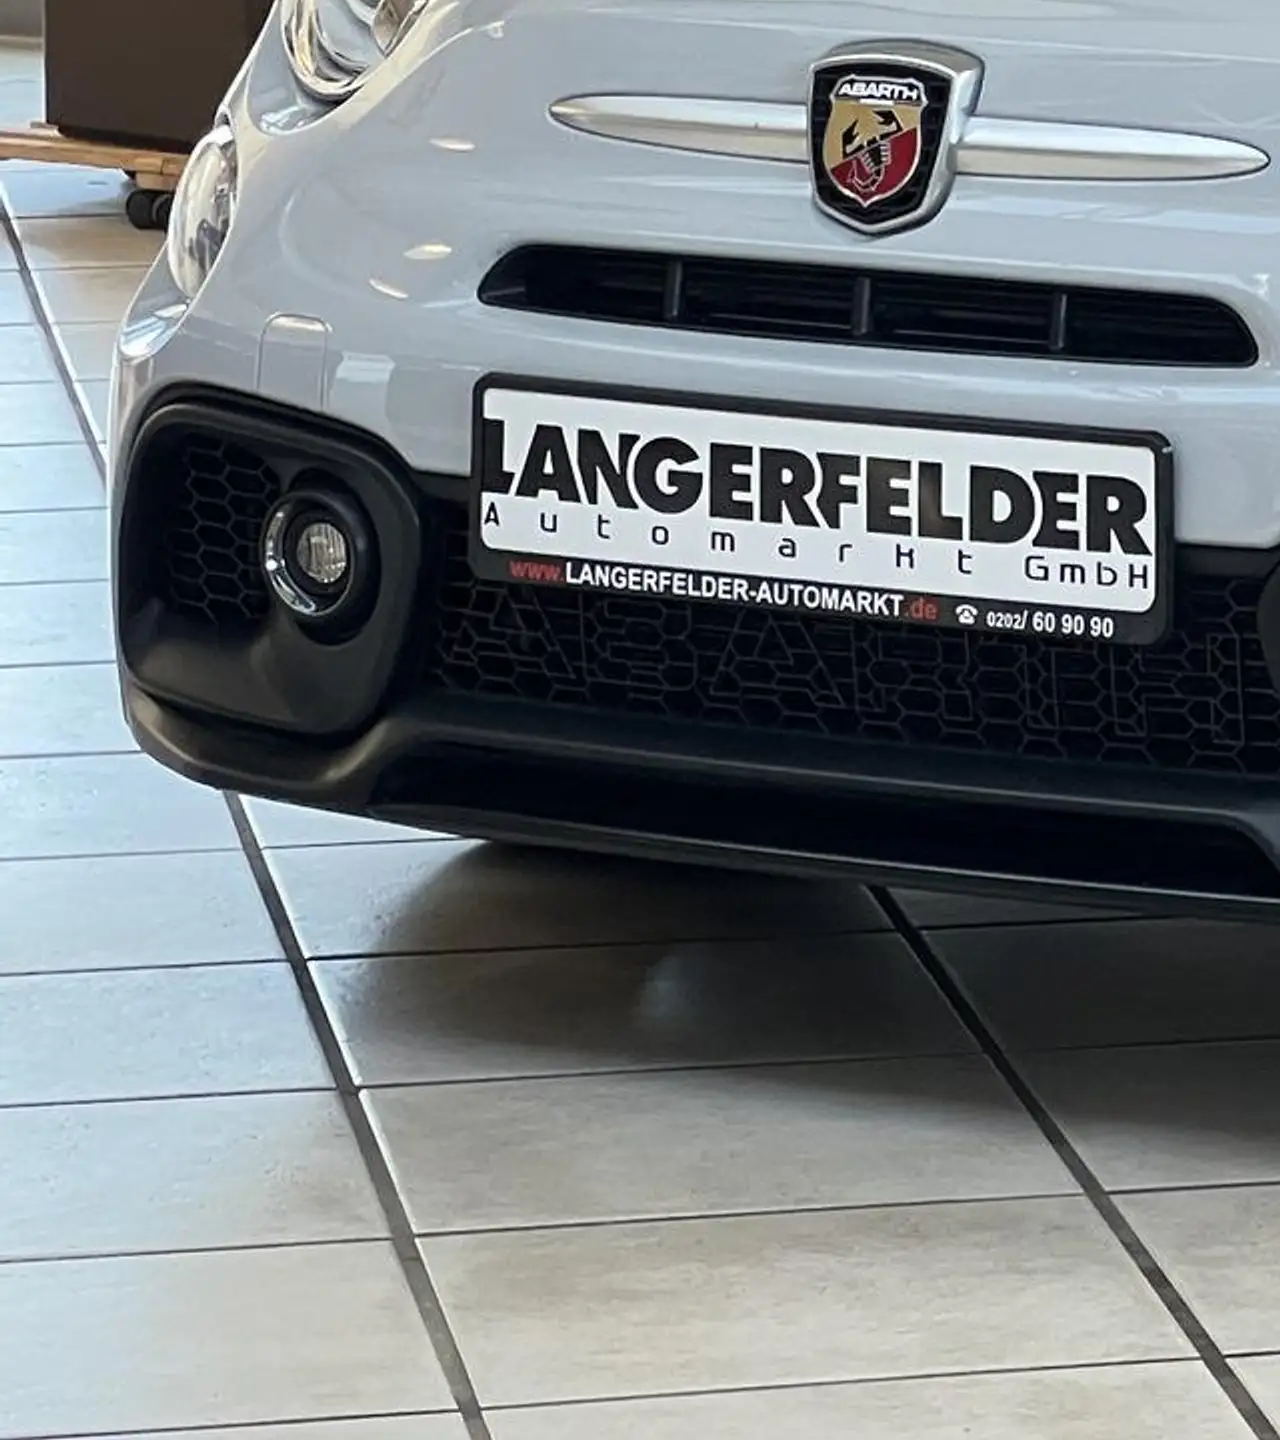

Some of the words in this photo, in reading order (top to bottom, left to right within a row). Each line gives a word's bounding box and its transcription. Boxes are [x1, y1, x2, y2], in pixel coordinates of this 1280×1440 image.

[839, 81, 918, 101] ABARTH
[480, 418, 1153, 556] LANGERFELDER
[1025, 554, 1149, 590] GmbH
